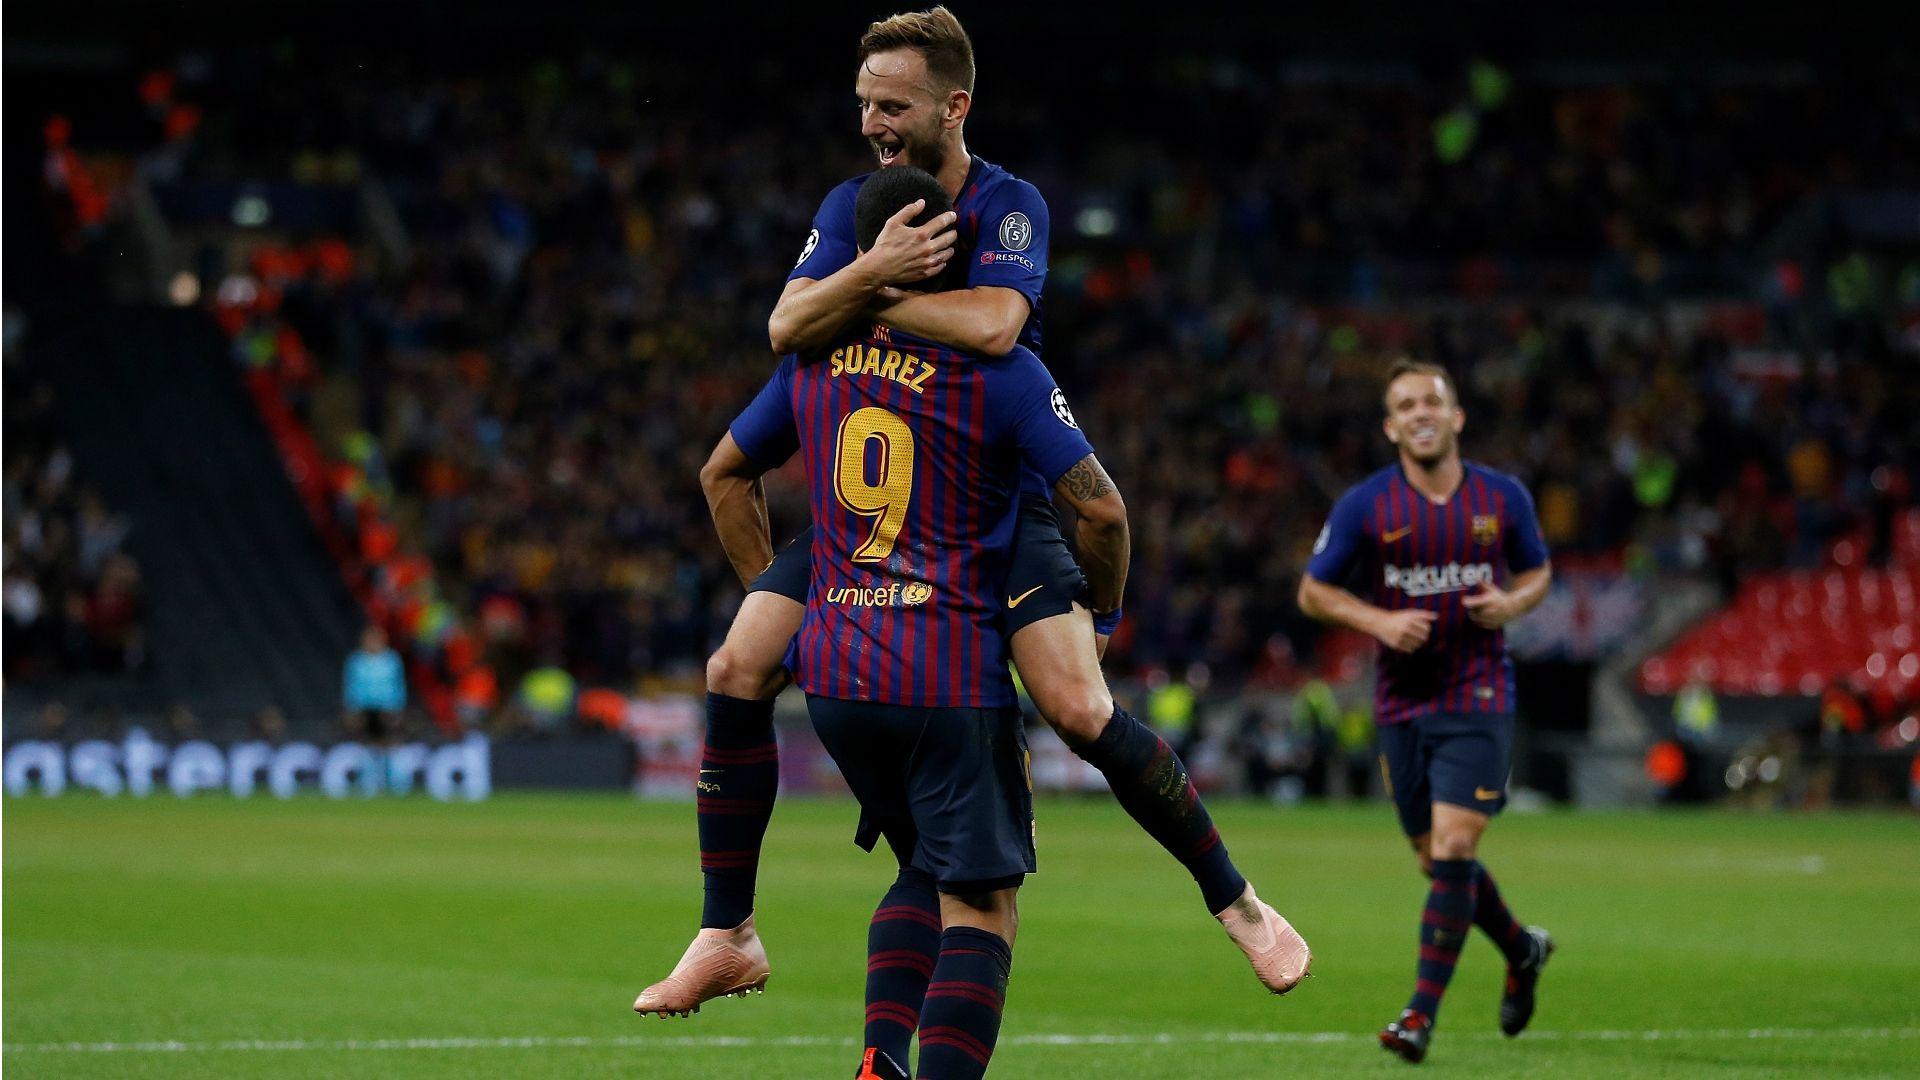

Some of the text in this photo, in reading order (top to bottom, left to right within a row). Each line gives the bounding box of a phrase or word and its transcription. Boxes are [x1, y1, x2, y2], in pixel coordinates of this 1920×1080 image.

[1011, 230, 1021, 241] 5
[995, 253, 1034, 270] RESPECT
[830, 344, 936, 395] SUAREZ
[833, 406, 915, 563] 9
[1384, 561, 1493, 594] Rakuten
[826, 583, 899, 607] unicef
